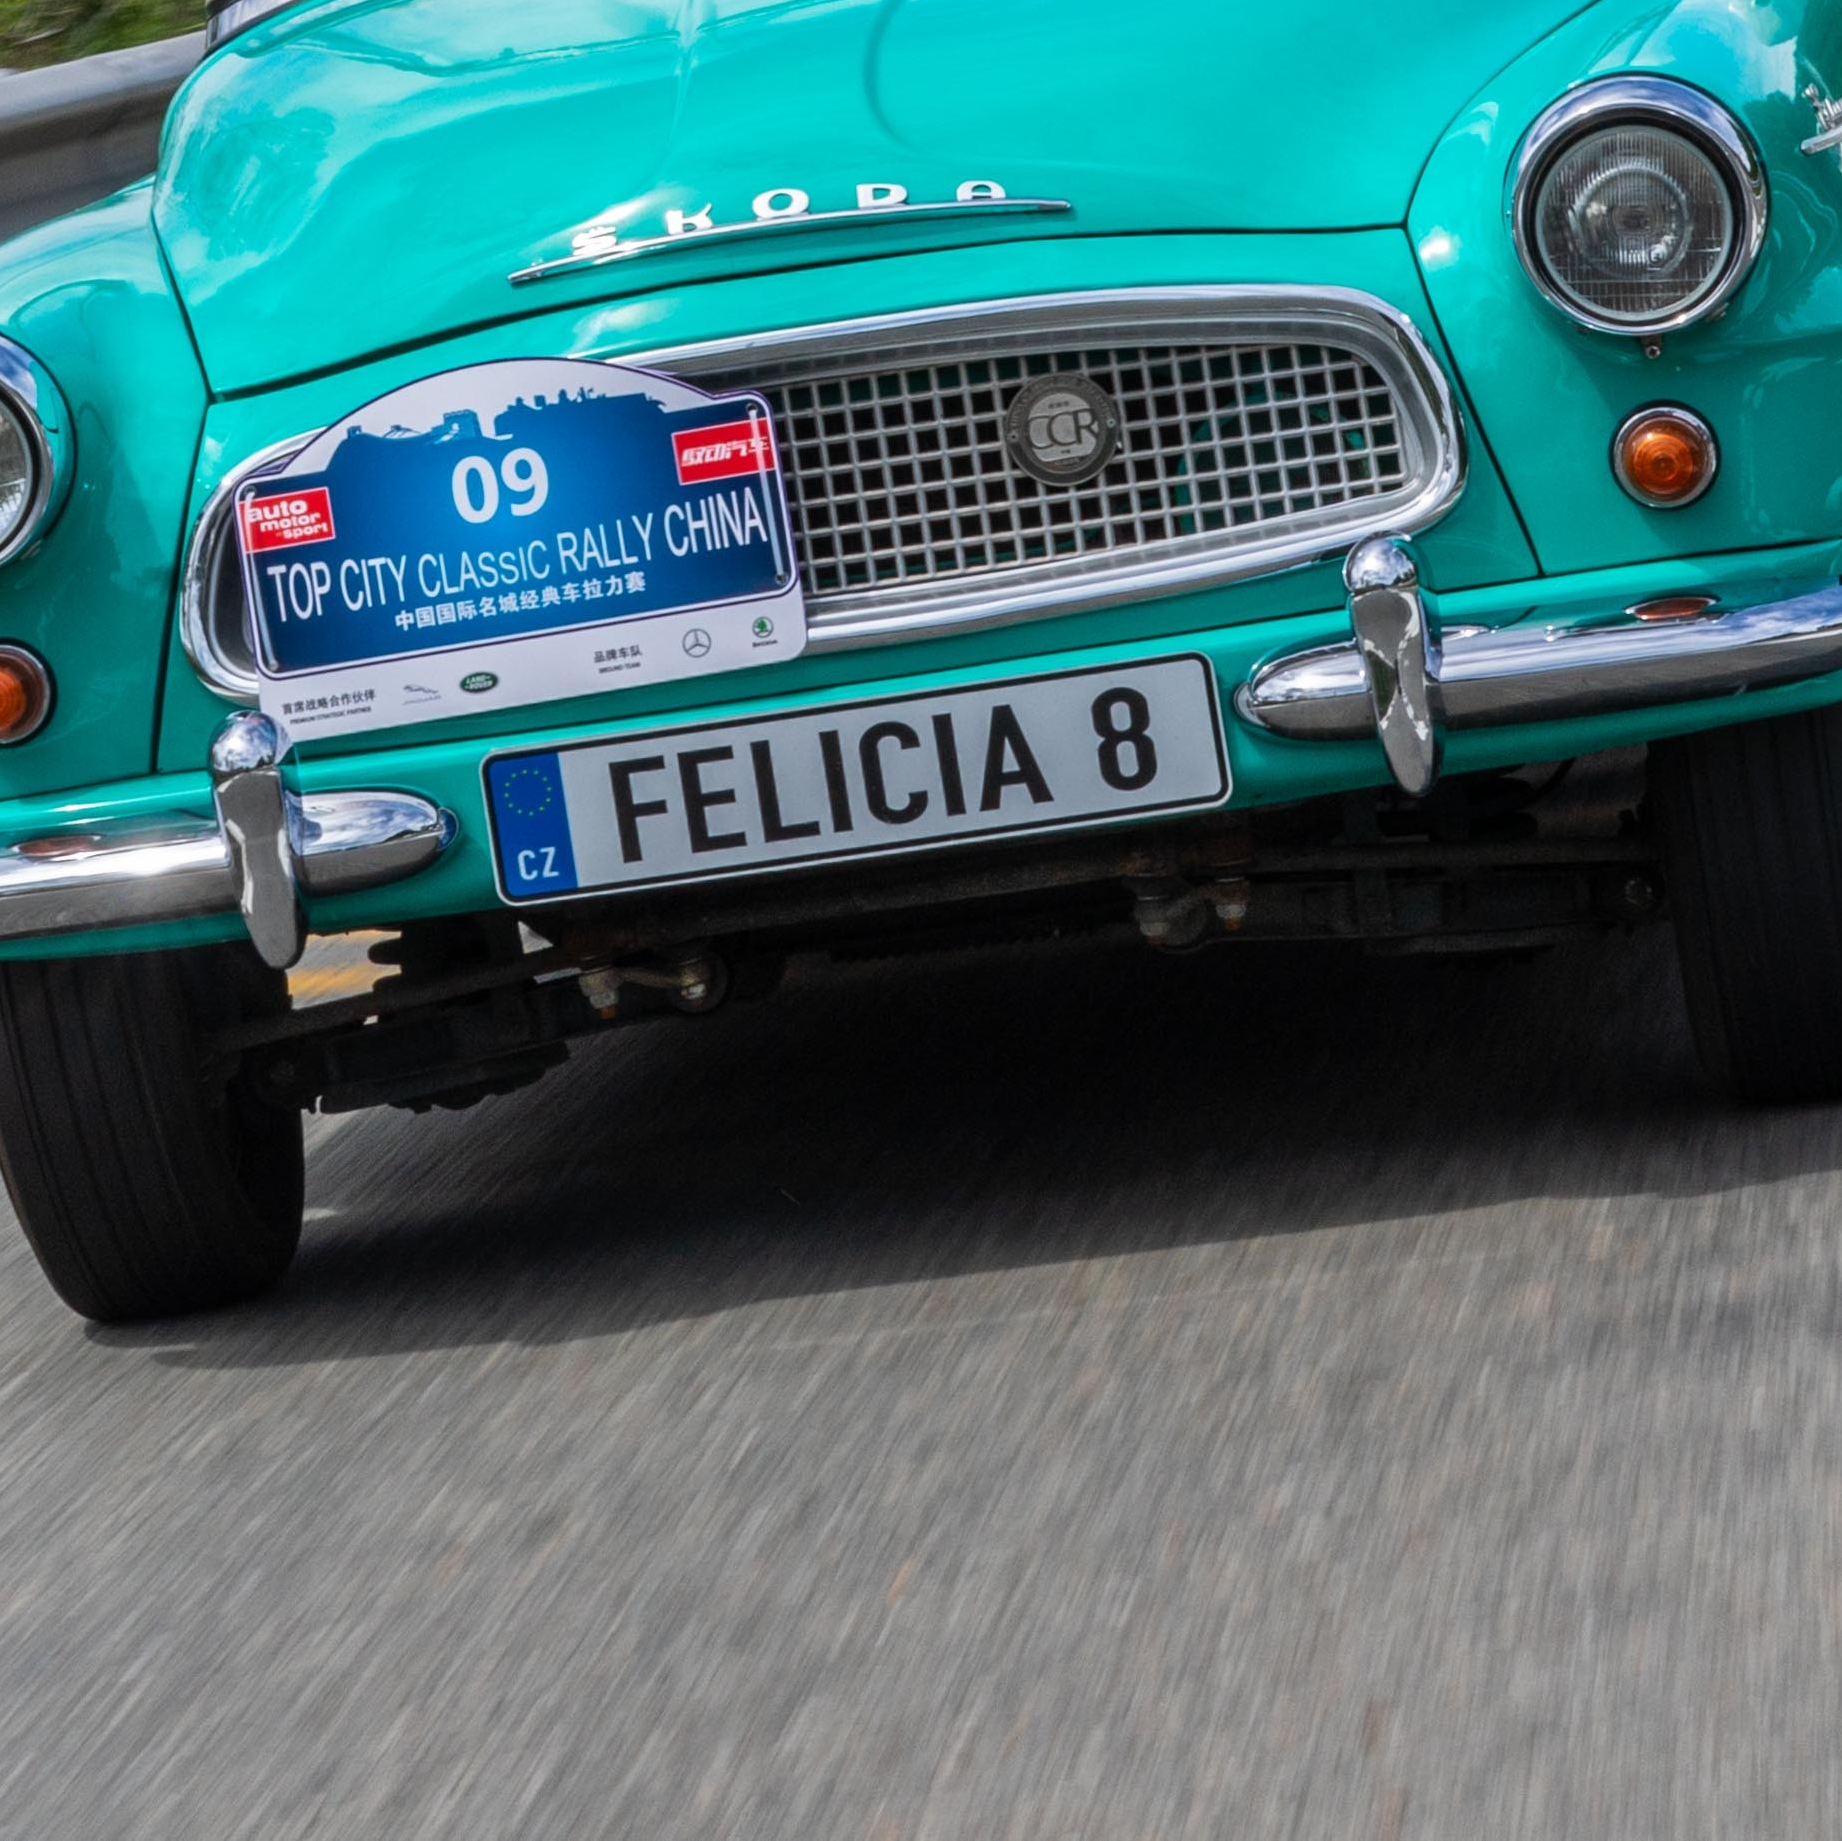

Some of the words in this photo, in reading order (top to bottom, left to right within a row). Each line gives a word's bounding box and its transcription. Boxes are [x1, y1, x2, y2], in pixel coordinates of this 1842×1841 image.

[452, 447, 549, 524] 09
[247, 500, 308, 524] auto
[260, 512, 321, 532] motor
[282, 522, 329, 539] sport
[266, 561, 331, 622] TOP
[340, 555, 406, 611] CITY
[418, 540, 550, 598] CLASSIC
[557, 512, 653, 574] RALLY
[664, 486, 768, 557] CHINA
[394, 571, 646, 631] 中国国际名城经典车拉力赛
[608, 703, 1053, 864] FELICIA
[1090, 686, 1159, 792] 8
[518, 846, 559, 880] CZ
